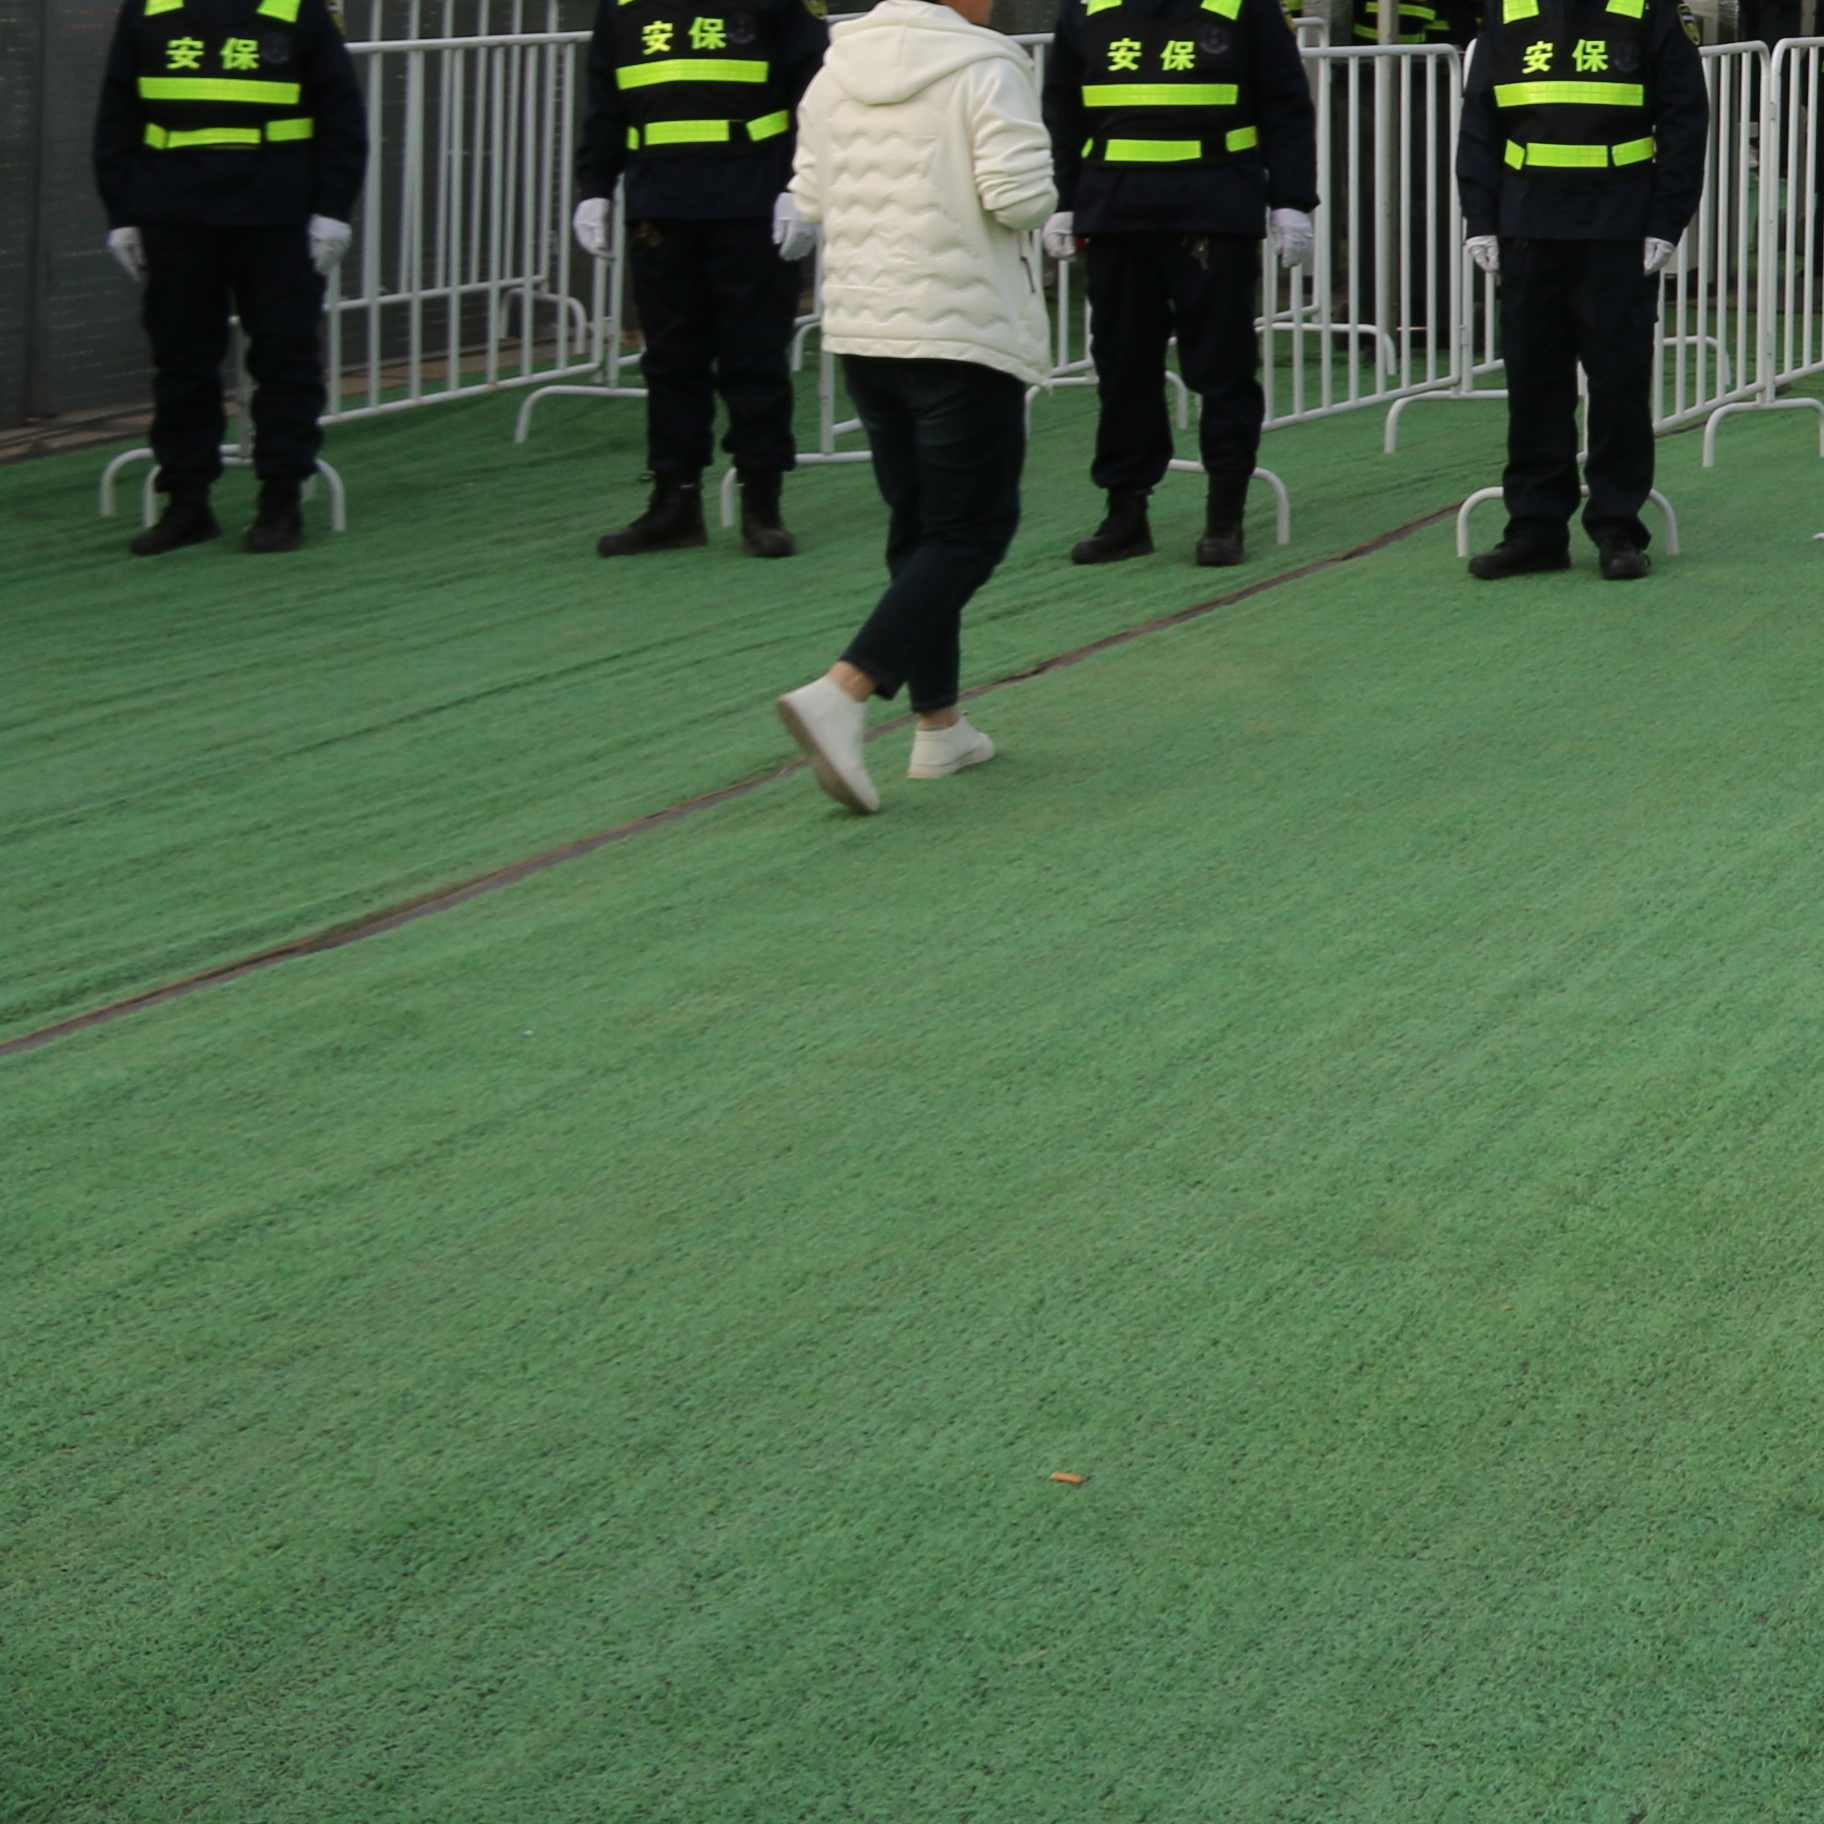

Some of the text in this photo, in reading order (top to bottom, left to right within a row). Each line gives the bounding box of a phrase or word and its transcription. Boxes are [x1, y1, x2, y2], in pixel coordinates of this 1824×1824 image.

[166, 36, 260, 71] 安保
[641, 16, 727, 56] 安保
[1106, 37, 1196, 72] 安保
[1521, 38, 1609, 75] 安保
